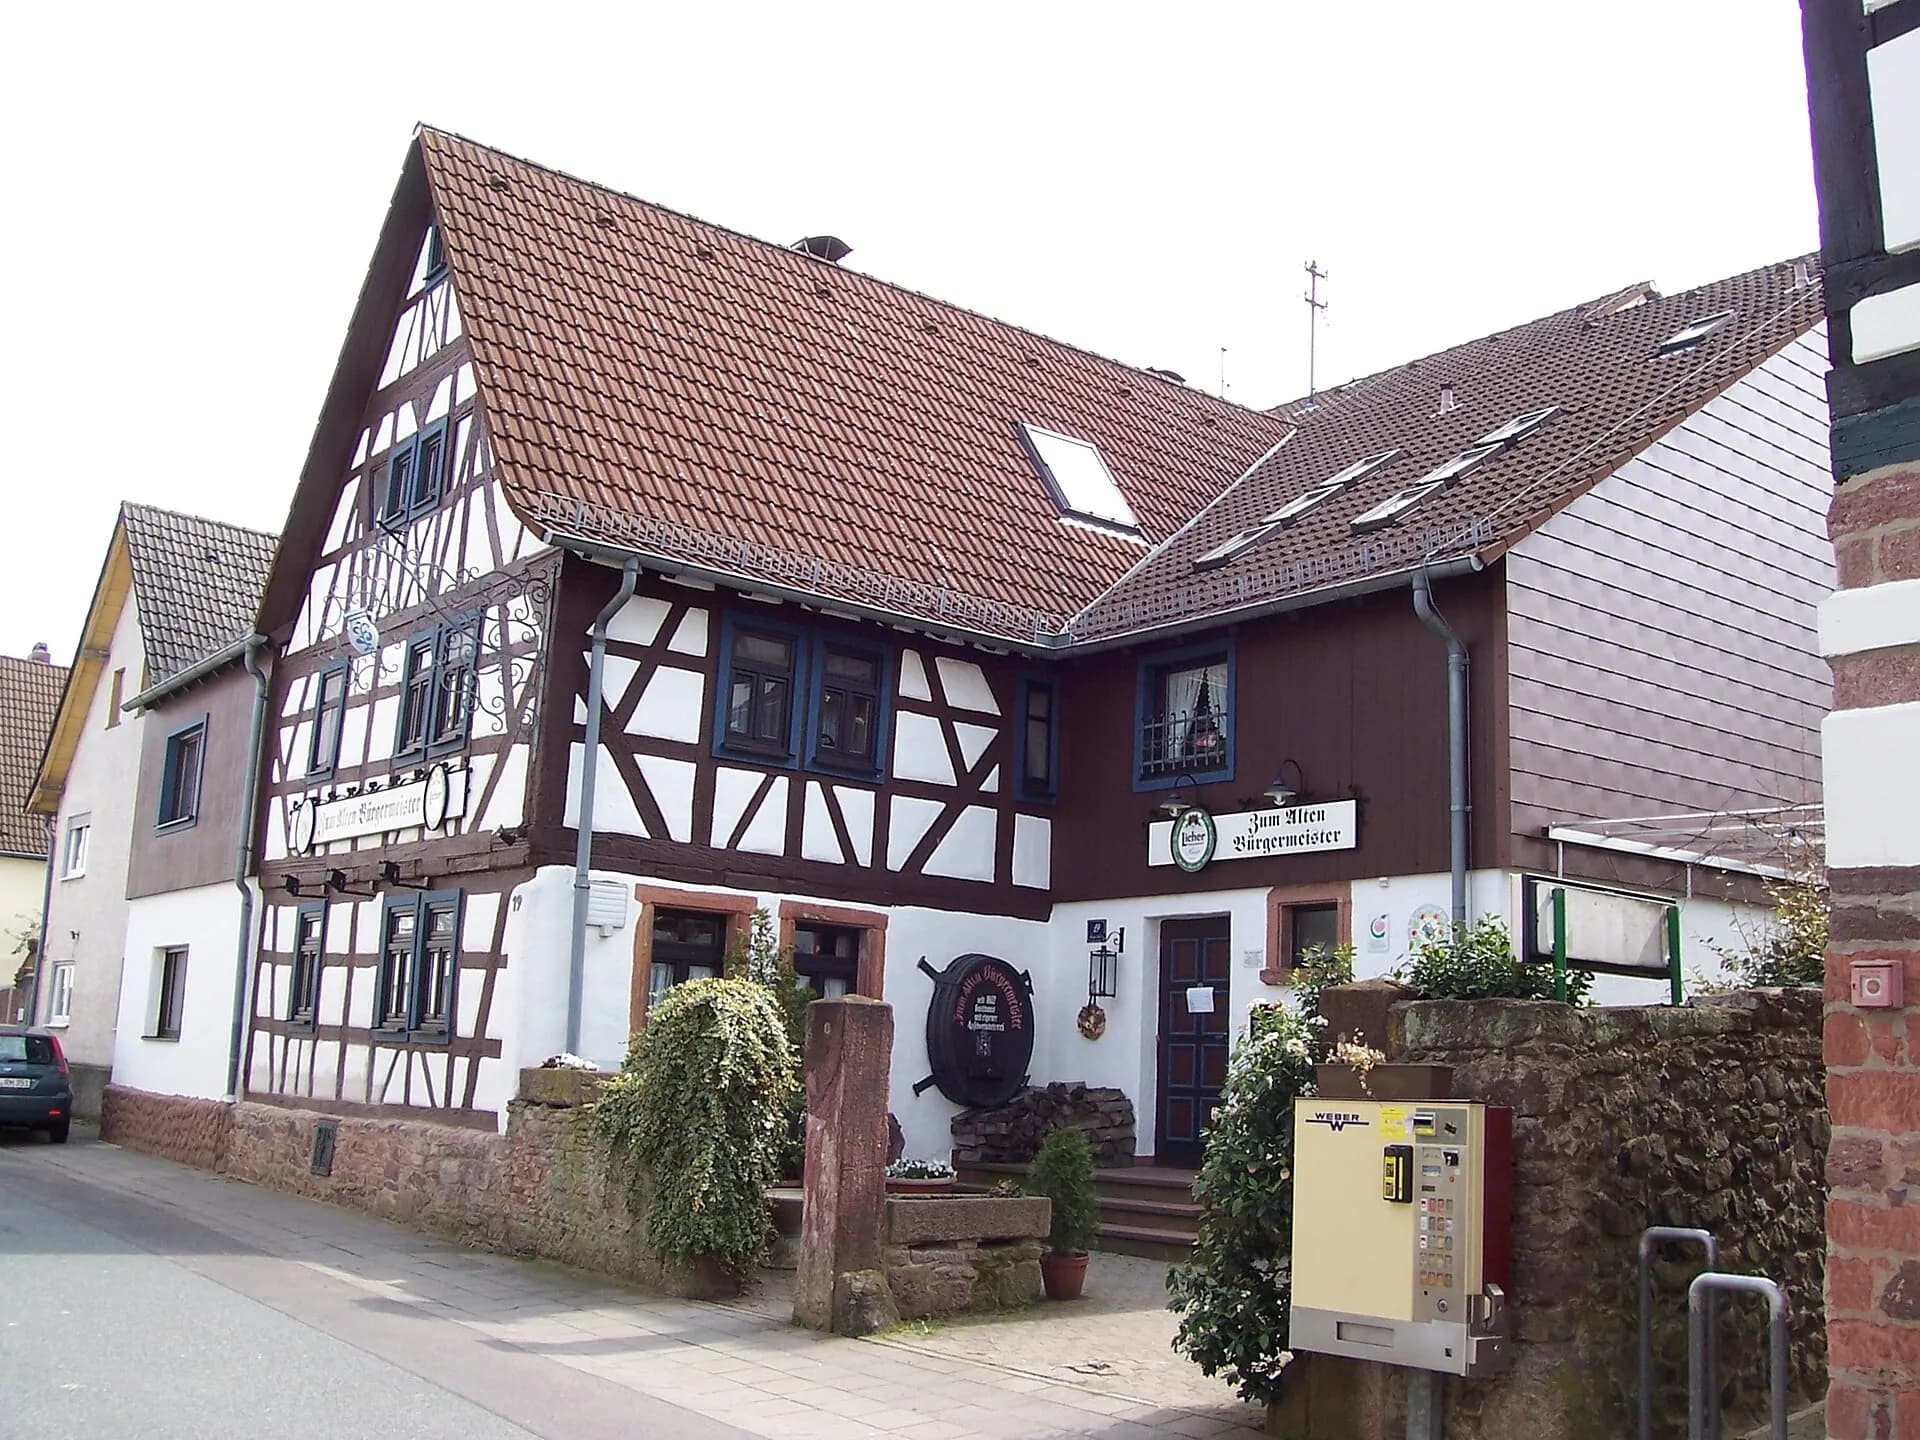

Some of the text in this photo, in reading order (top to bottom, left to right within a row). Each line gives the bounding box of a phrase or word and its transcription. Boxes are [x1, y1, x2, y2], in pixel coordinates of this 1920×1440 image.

[1248, 807, 1326, 835] Zum Alten
[1181, 831, 1206, 847] Licher
[1233, 829, 1342, 854] Bürgermeister
[1315, 1112, 1360, 1122] WEBER
